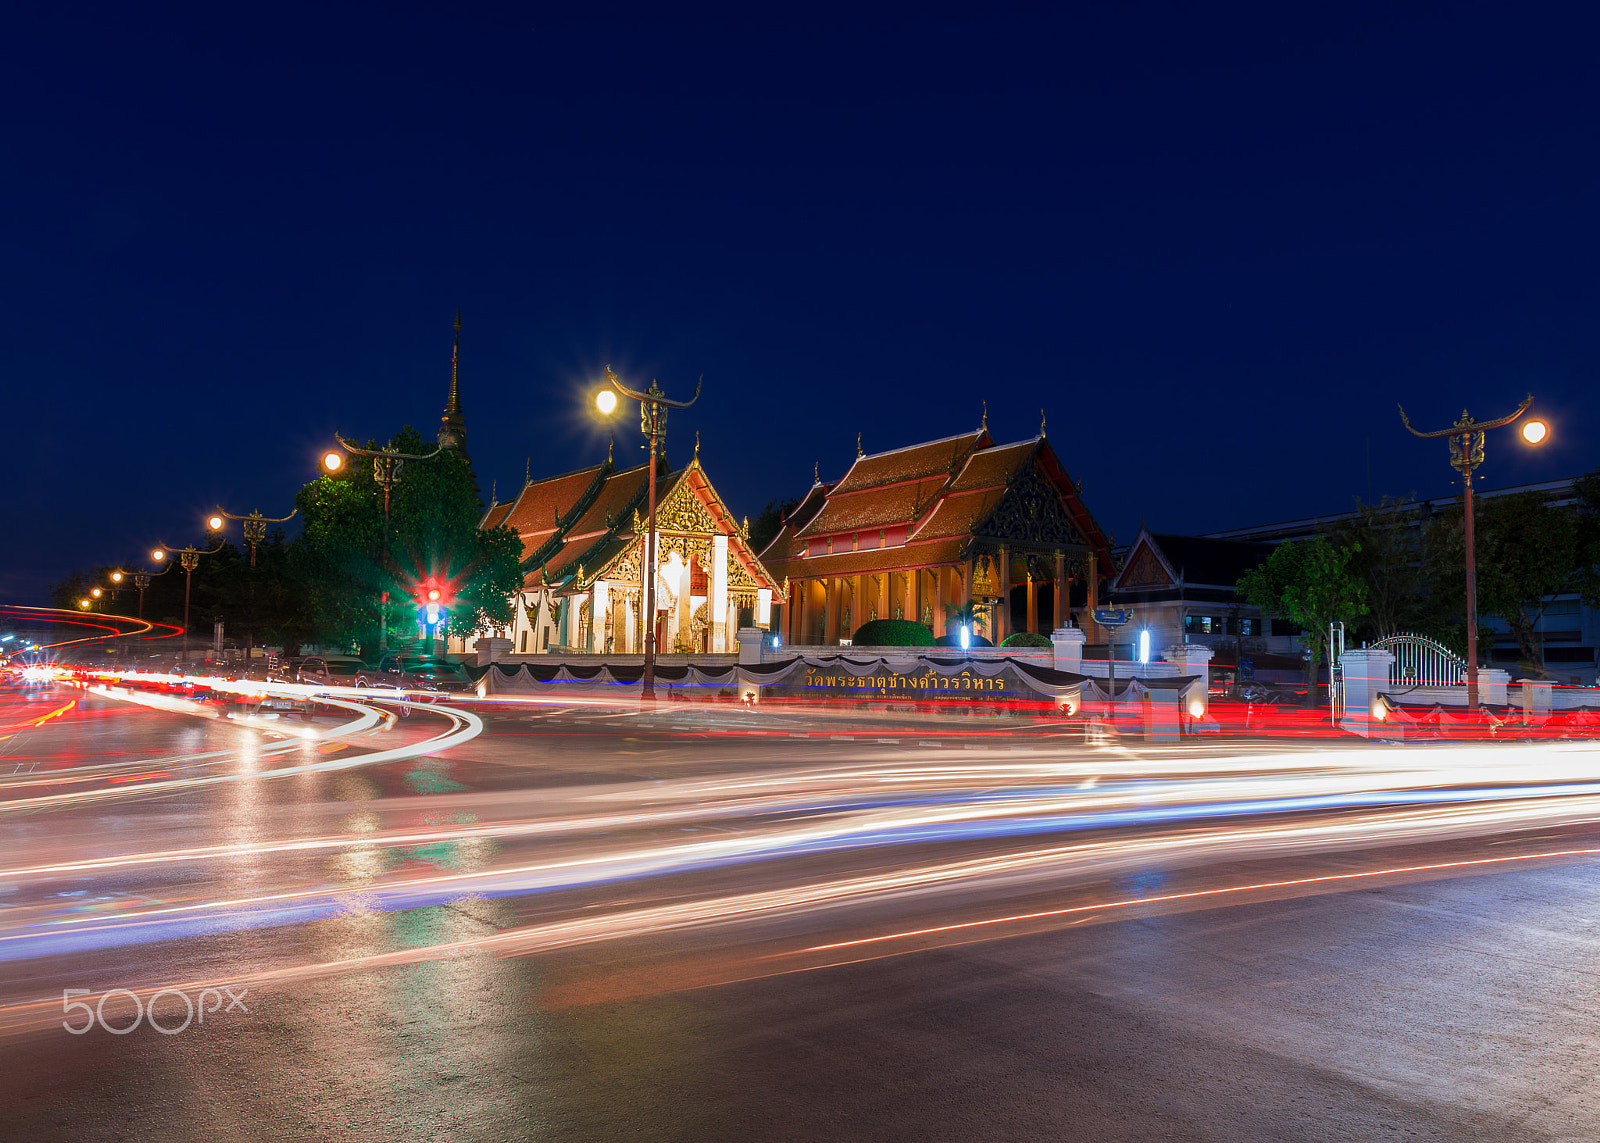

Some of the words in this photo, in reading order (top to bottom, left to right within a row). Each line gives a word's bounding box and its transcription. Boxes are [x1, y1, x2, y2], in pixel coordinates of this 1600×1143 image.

[804, 668, 1005, 694] วัดพระธาตุช้างค้ำวรวิหาร
